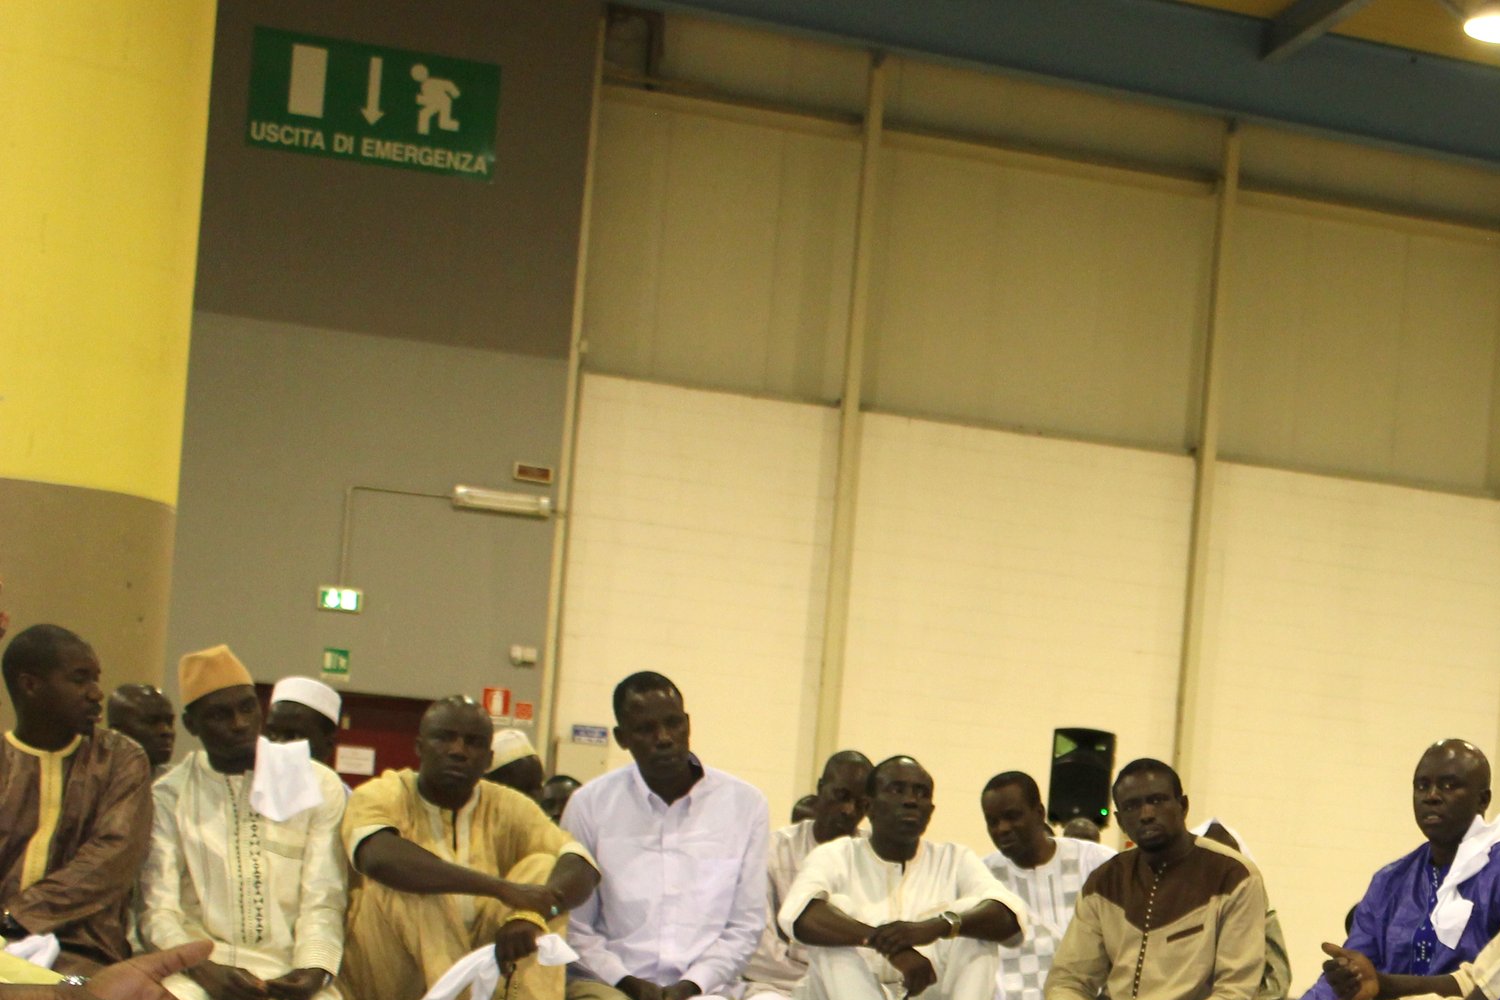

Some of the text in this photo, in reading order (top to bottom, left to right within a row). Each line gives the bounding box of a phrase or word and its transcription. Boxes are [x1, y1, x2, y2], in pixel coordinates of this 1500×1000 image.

[250, 121, 488, 174] USCITA DI EMERGENZA
